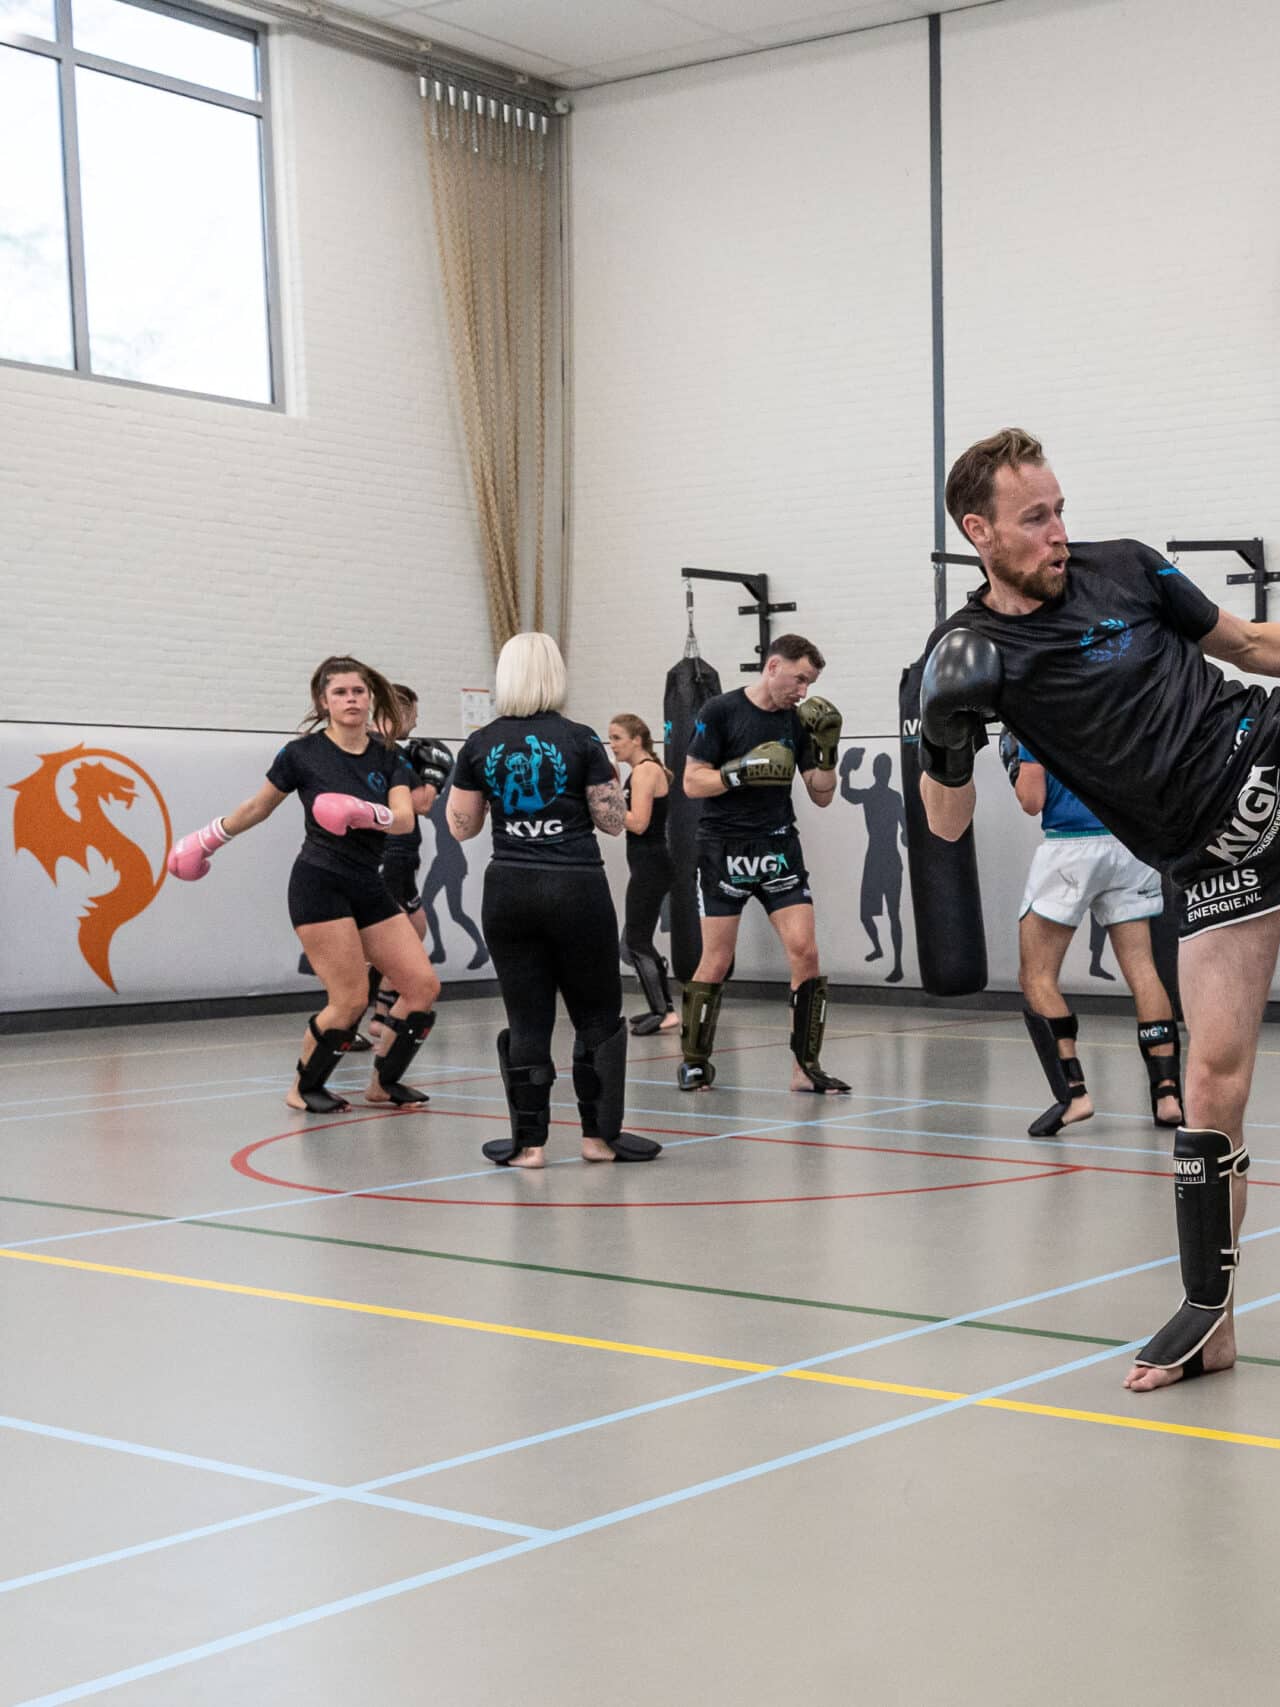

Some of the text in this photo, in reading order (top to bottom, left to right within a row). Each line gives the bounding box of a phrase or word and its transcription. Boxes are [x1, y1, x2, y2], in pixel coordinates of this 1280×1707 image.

[903, 719, 922, 736] KV
[505, 820, 564, 838] KVG
[1205, 788, 1276, 866] KVG
[726, 855, 778, 877] KVG
[1188, 892, 1263, 923] ENERGIE.NL
[1176, 1160, 1202, 1175] KKO
